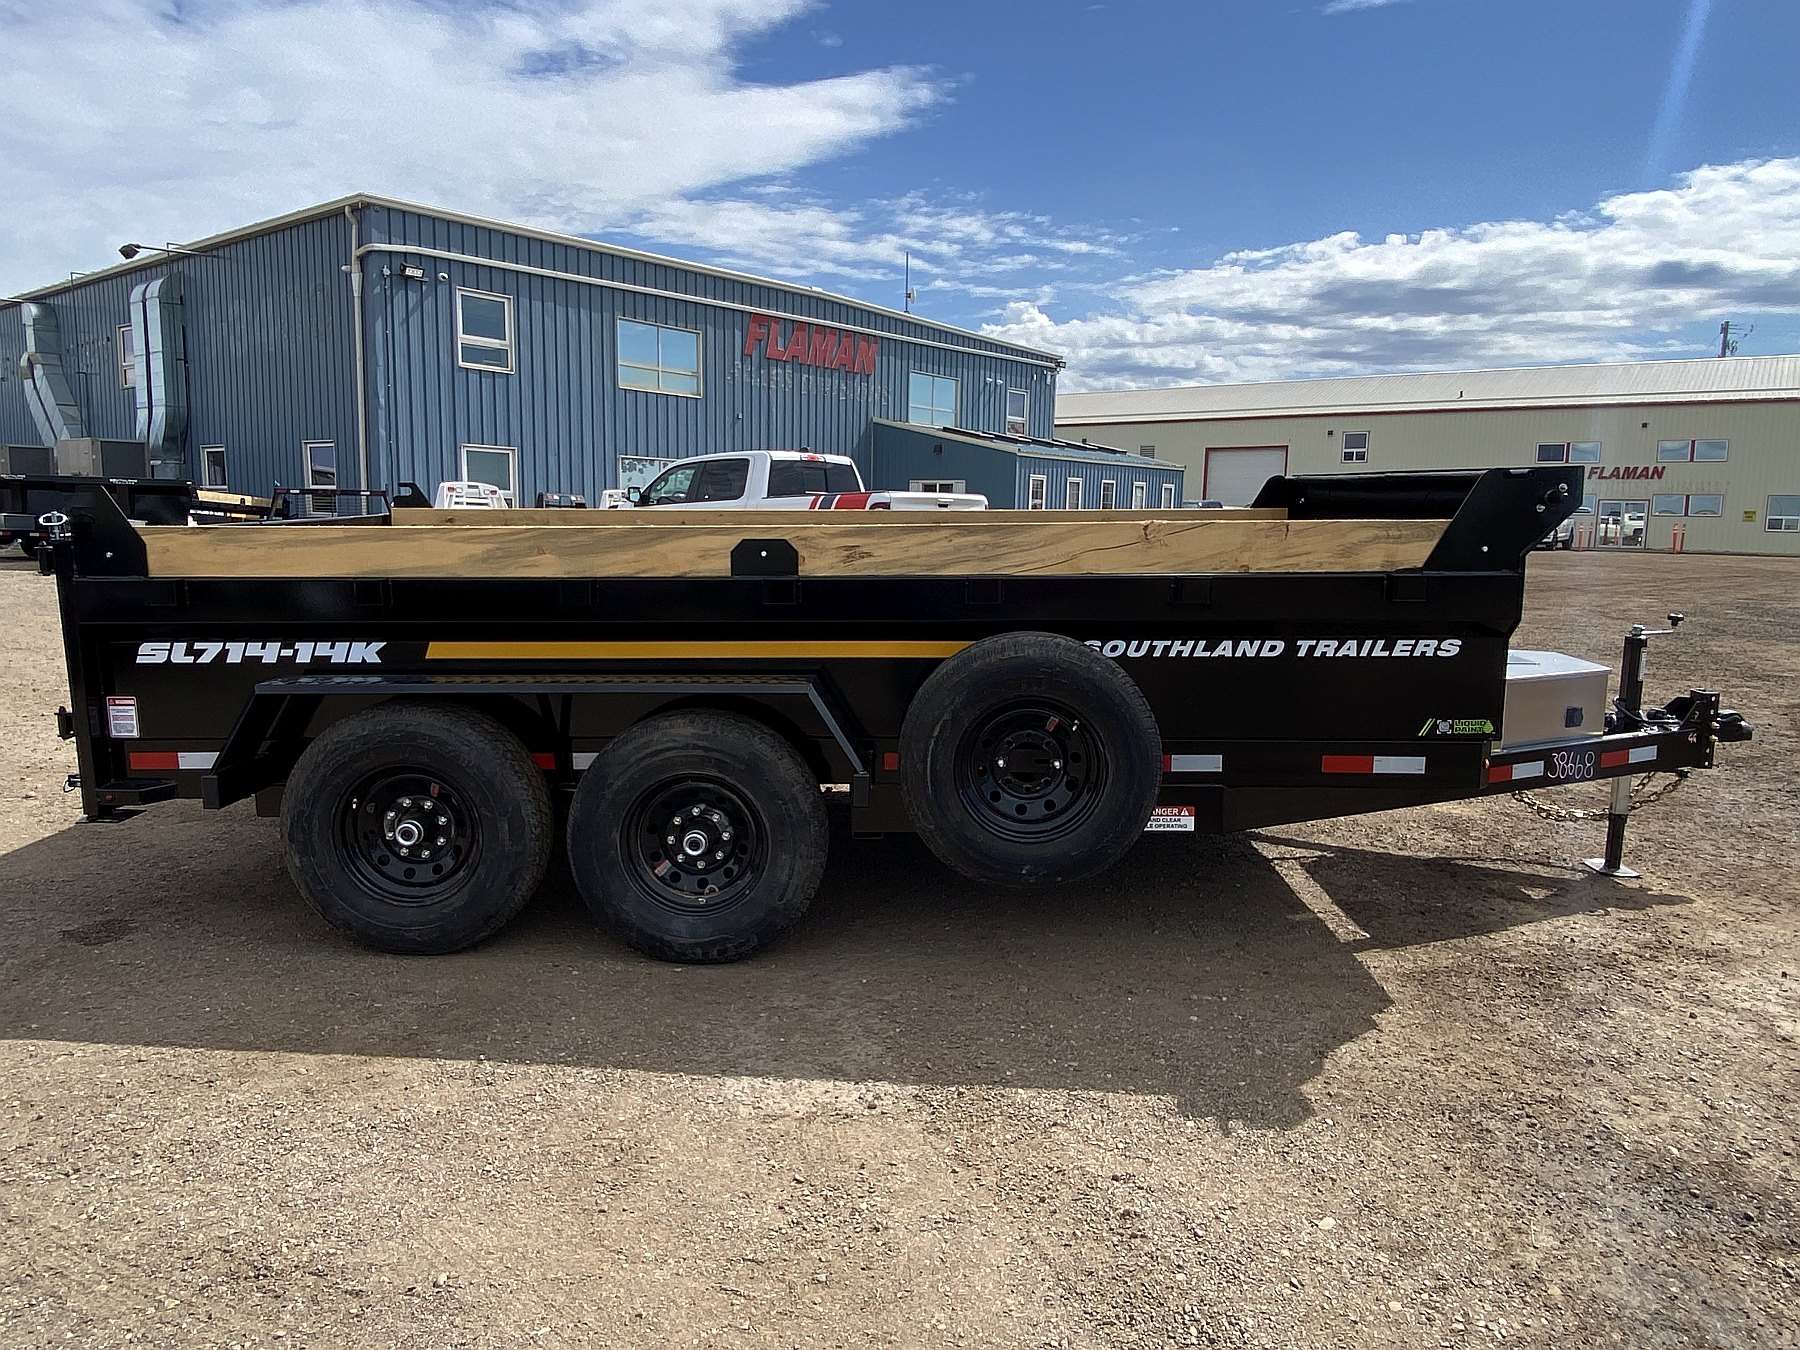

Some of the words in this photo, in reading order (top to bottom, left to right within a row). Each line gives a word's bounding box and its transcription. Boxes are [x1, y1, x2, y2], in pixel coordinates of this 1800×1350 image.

[744, 313, 879, 375] FLAMAN
[1587, 466, 1666, 480] FLAMAN
[136, 642, 387, 663] SL714-14K
[1297, 639, 1462, 657] TRAILERS
[1547, 751, 1595, 779] 38668
